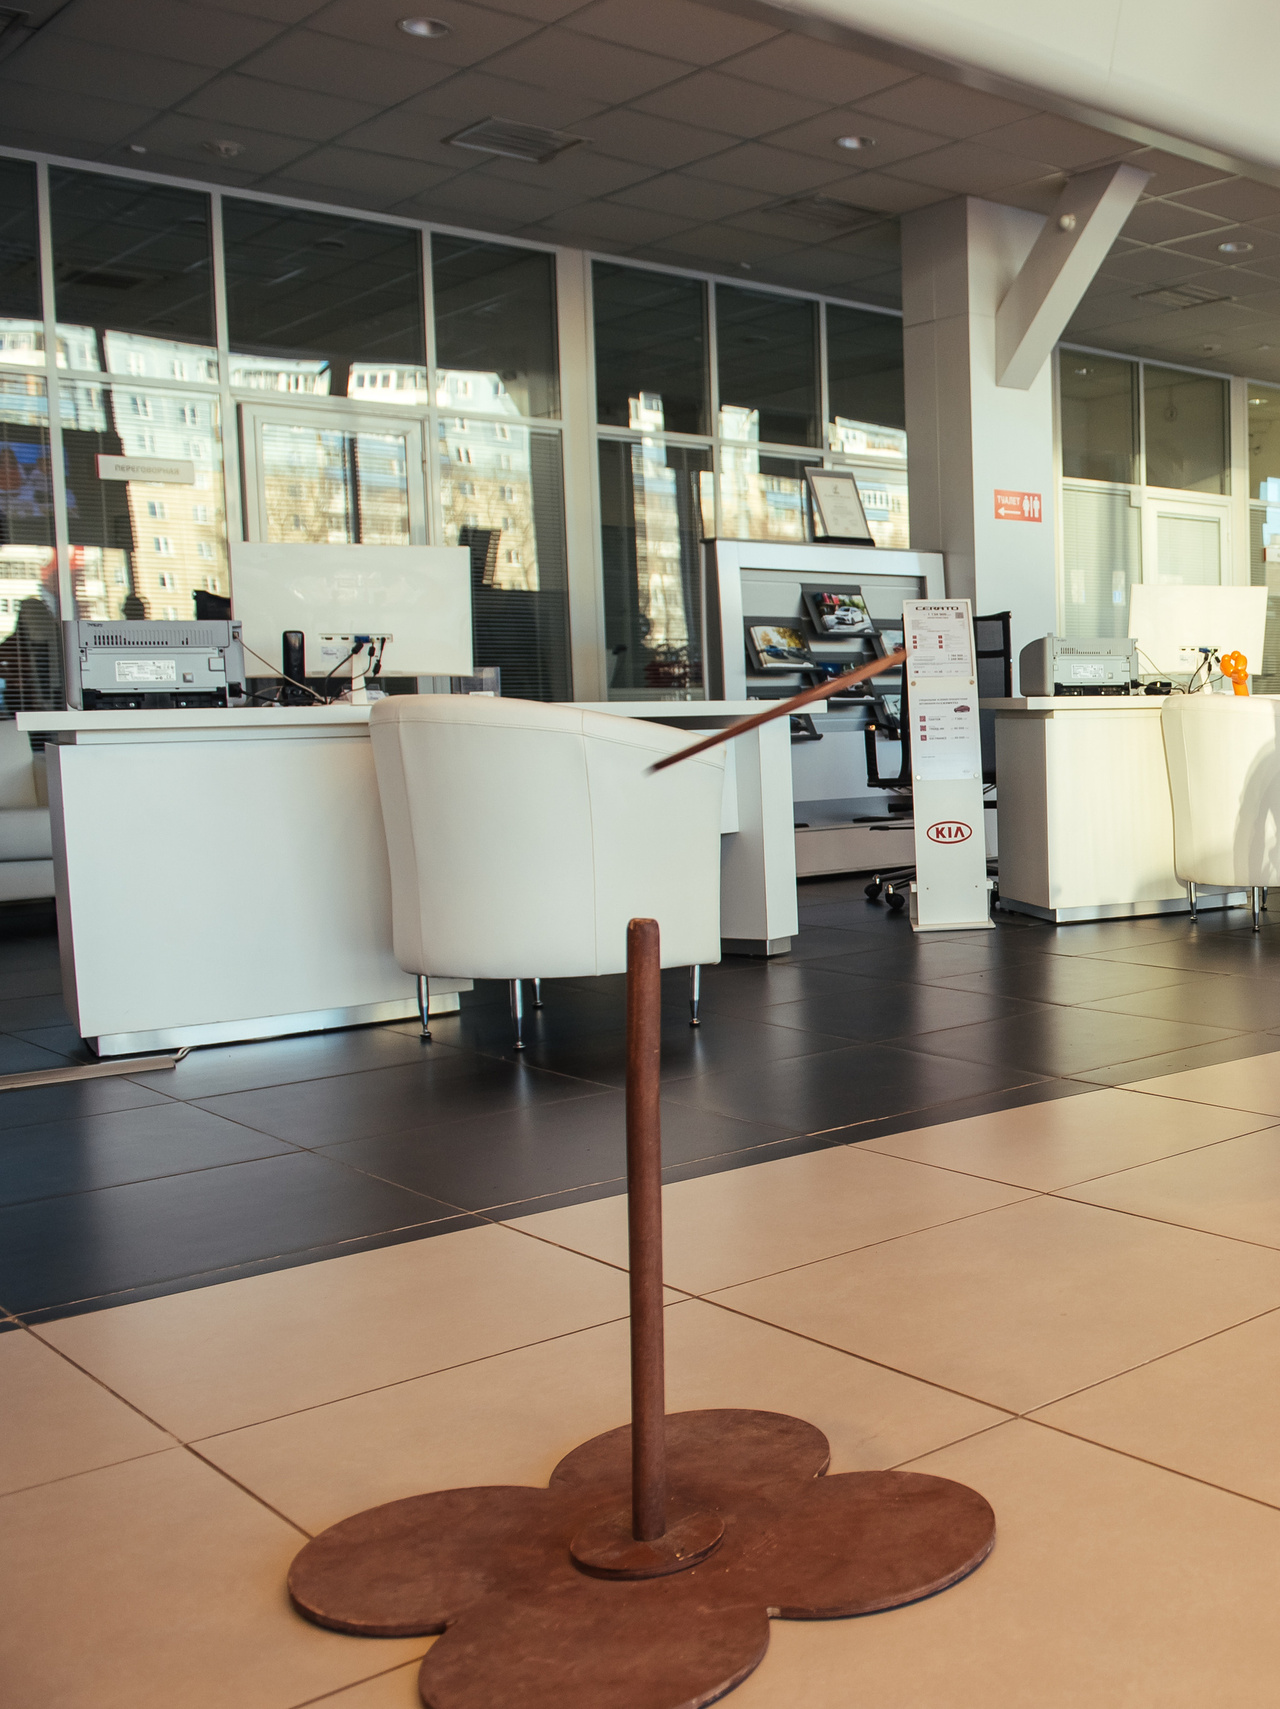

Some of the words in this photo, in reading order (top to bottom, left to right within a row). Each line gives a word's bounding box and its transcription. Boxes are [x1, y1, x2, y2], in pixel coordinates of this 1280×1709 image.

[114, 464, 180, 476] ПЕРЕГОВОРНАЯ
[997, 495, 1021, 506] ТУАЛЕТ
[935, 826, 966, 839] KIA
